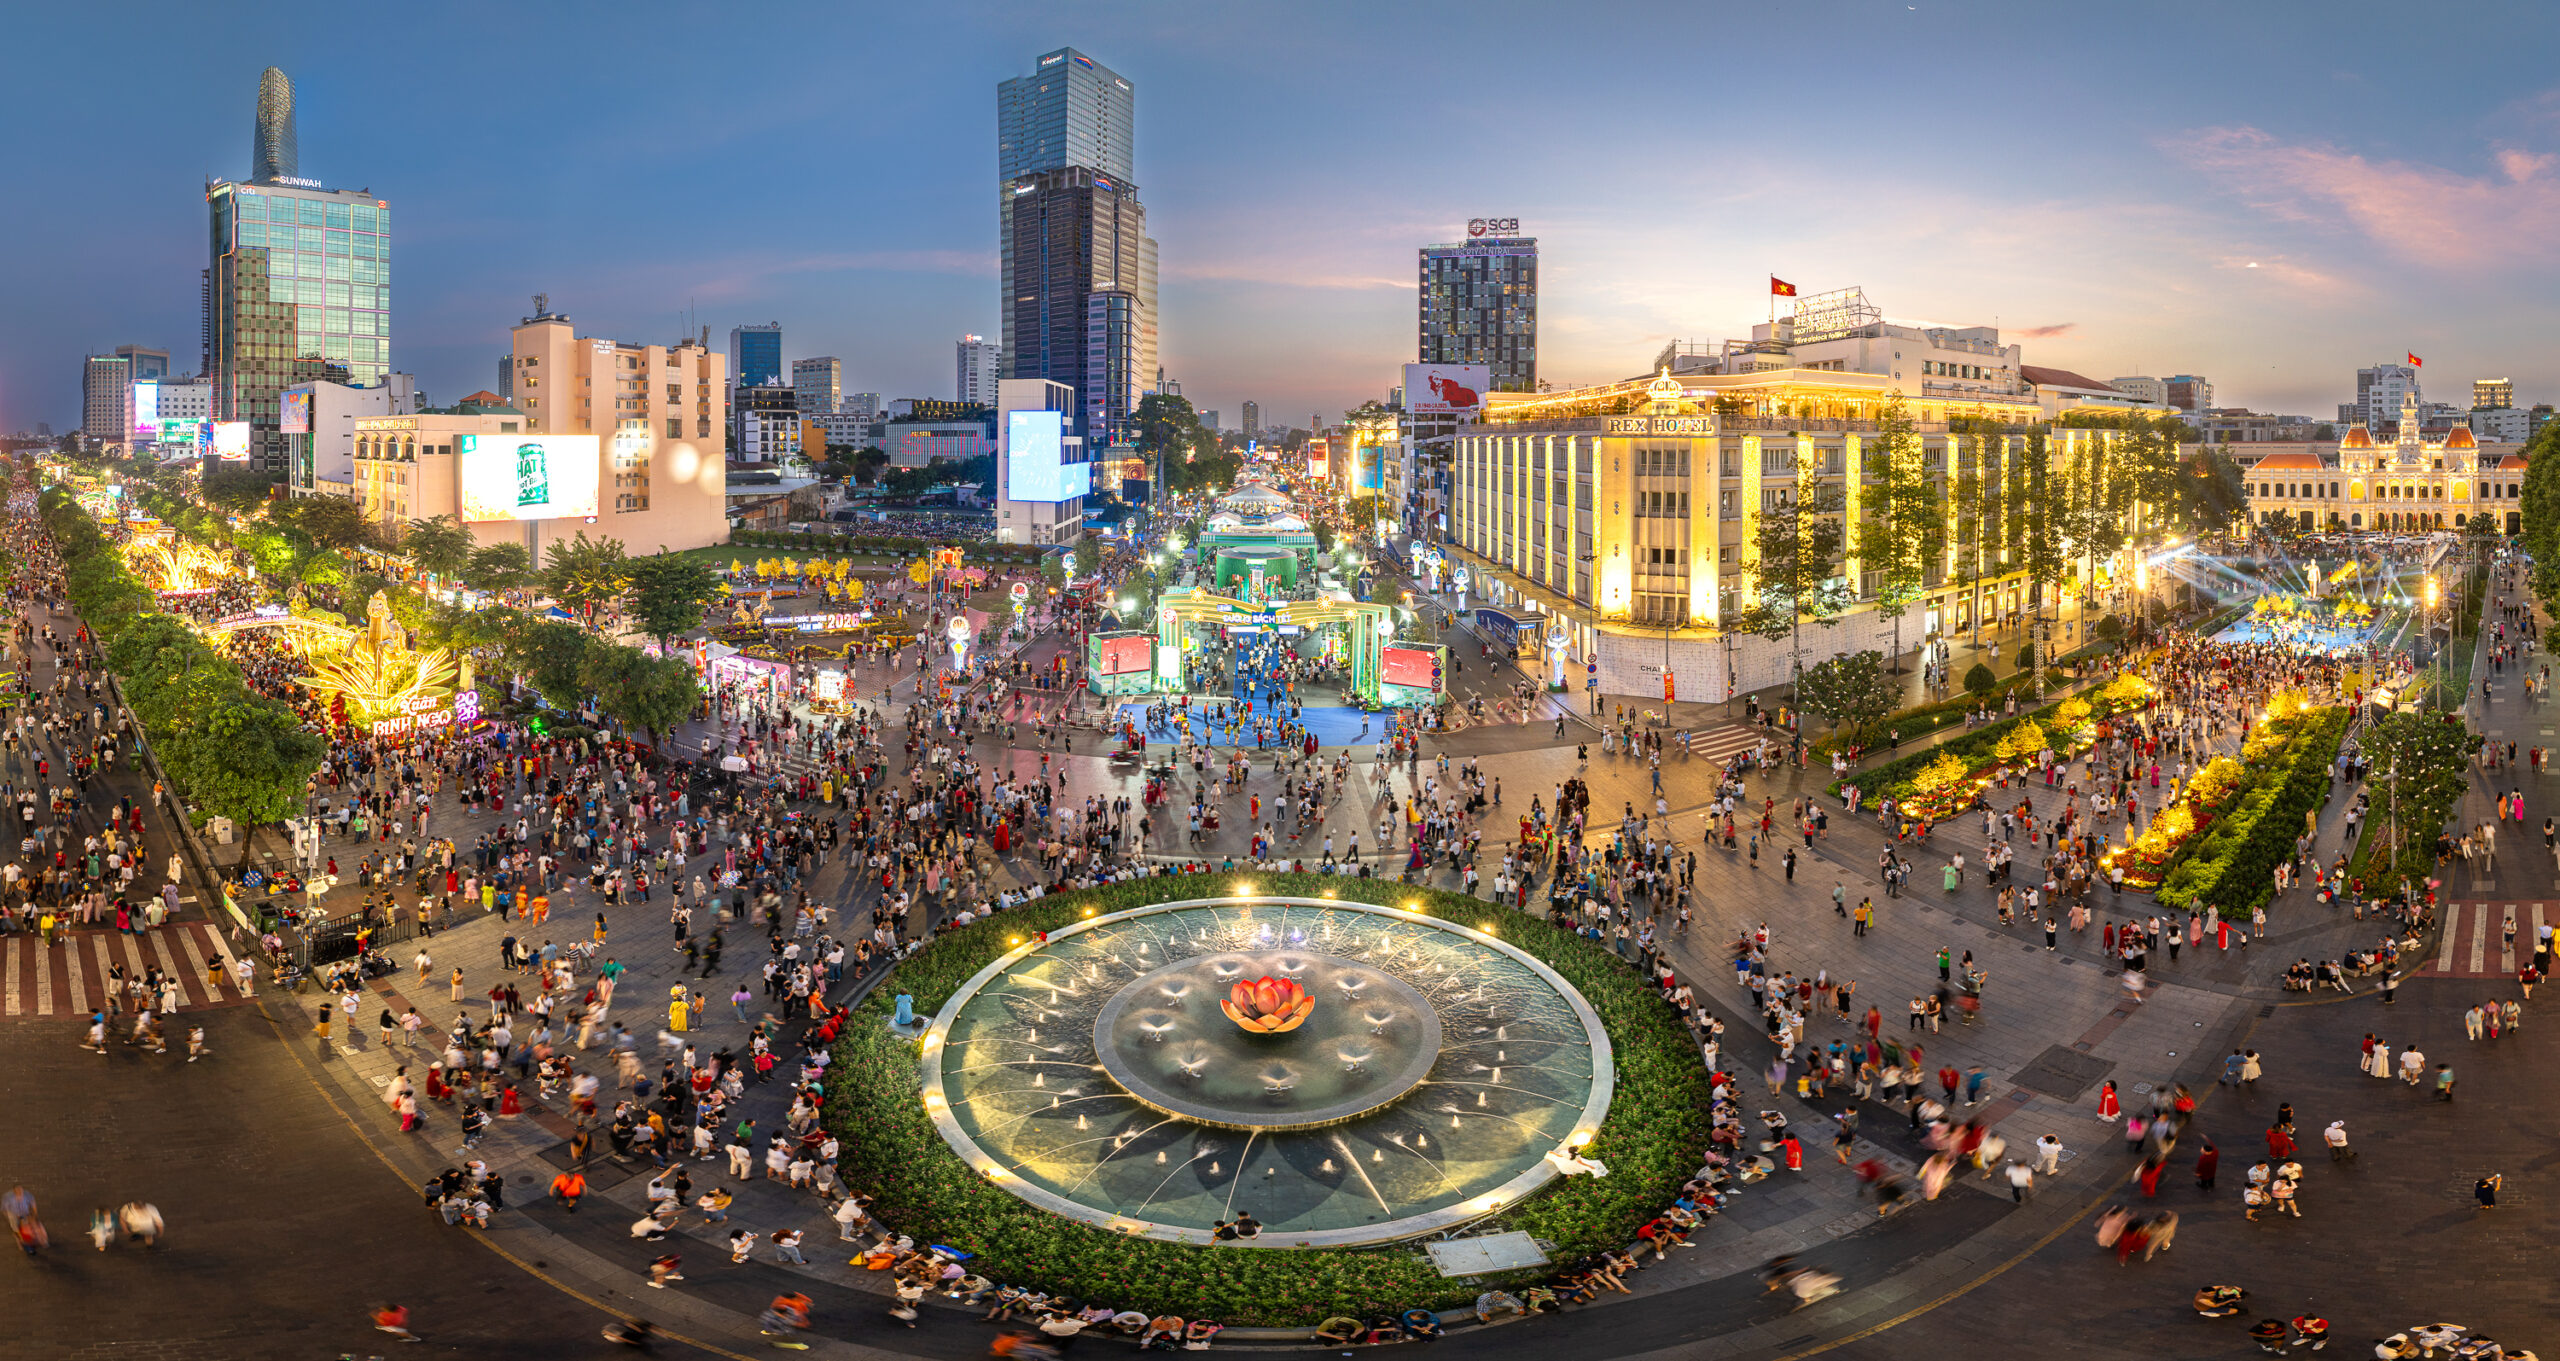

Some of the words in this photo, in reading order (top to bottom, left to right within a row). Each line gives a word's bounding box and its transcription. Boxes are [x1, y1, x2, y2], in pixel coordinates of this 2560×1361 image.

[280, 175, 322, 188] SUNWAH
[1488, 218, 1519, 231] SCB
[1609, 418, 1648, 433] REX
[1653, 418, 1713, 433] HOTEL
[827, 613, 860, 630] 2026
